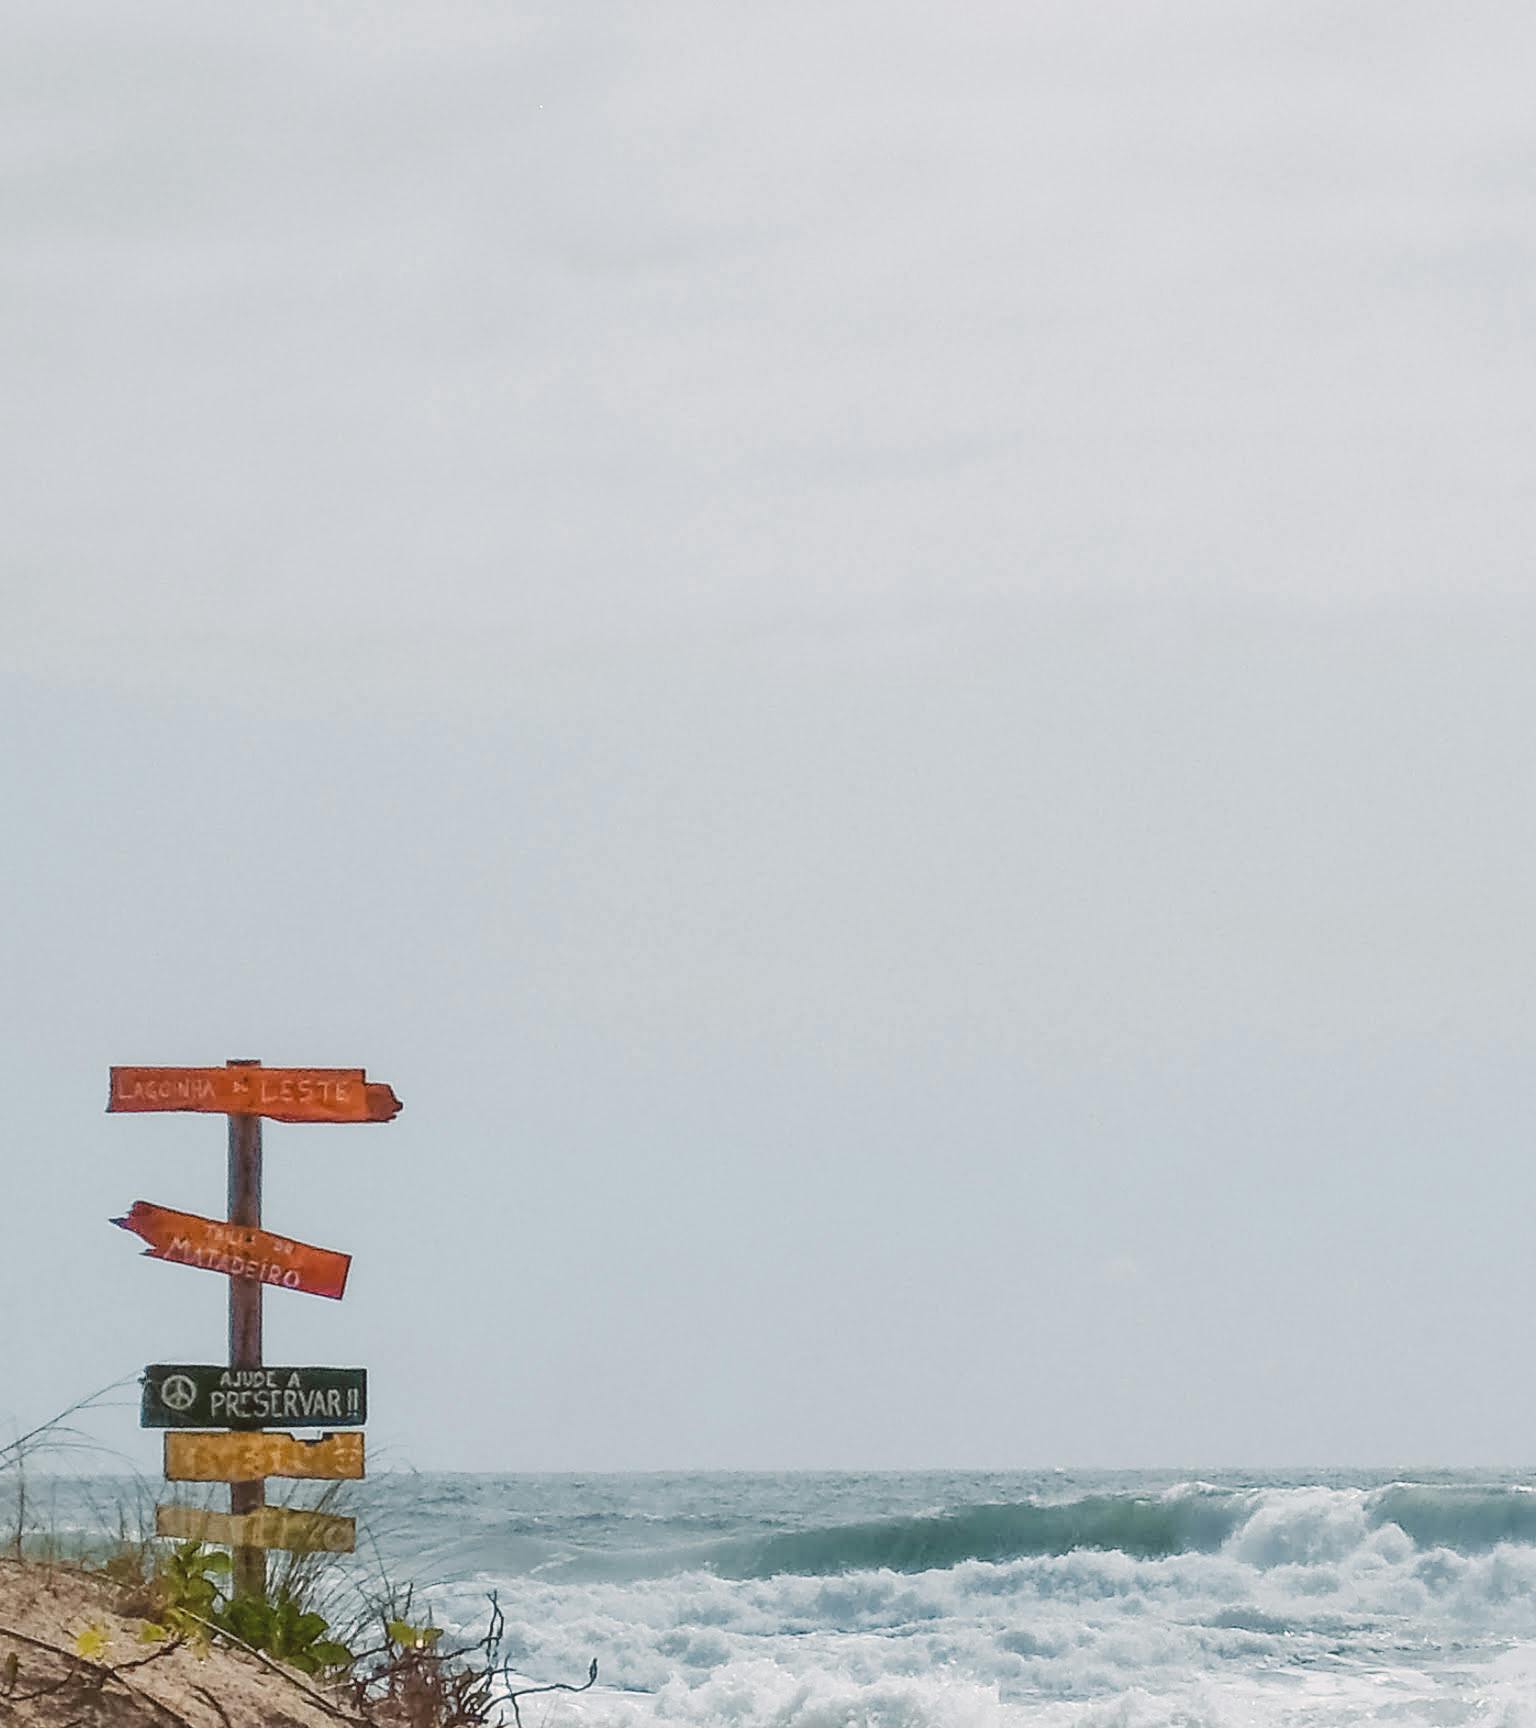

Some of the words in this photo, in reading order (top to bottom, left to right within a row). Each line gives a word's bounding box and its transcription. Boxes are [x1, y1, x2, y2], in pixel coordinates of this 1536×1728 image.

[261, 1079, 351, 1103] LESTE
[164, 1236, 300, 1289] MATADEIRO
[220, 1370, 277, 1388] AJUDE
[287, 1371, 302, 1388] A
